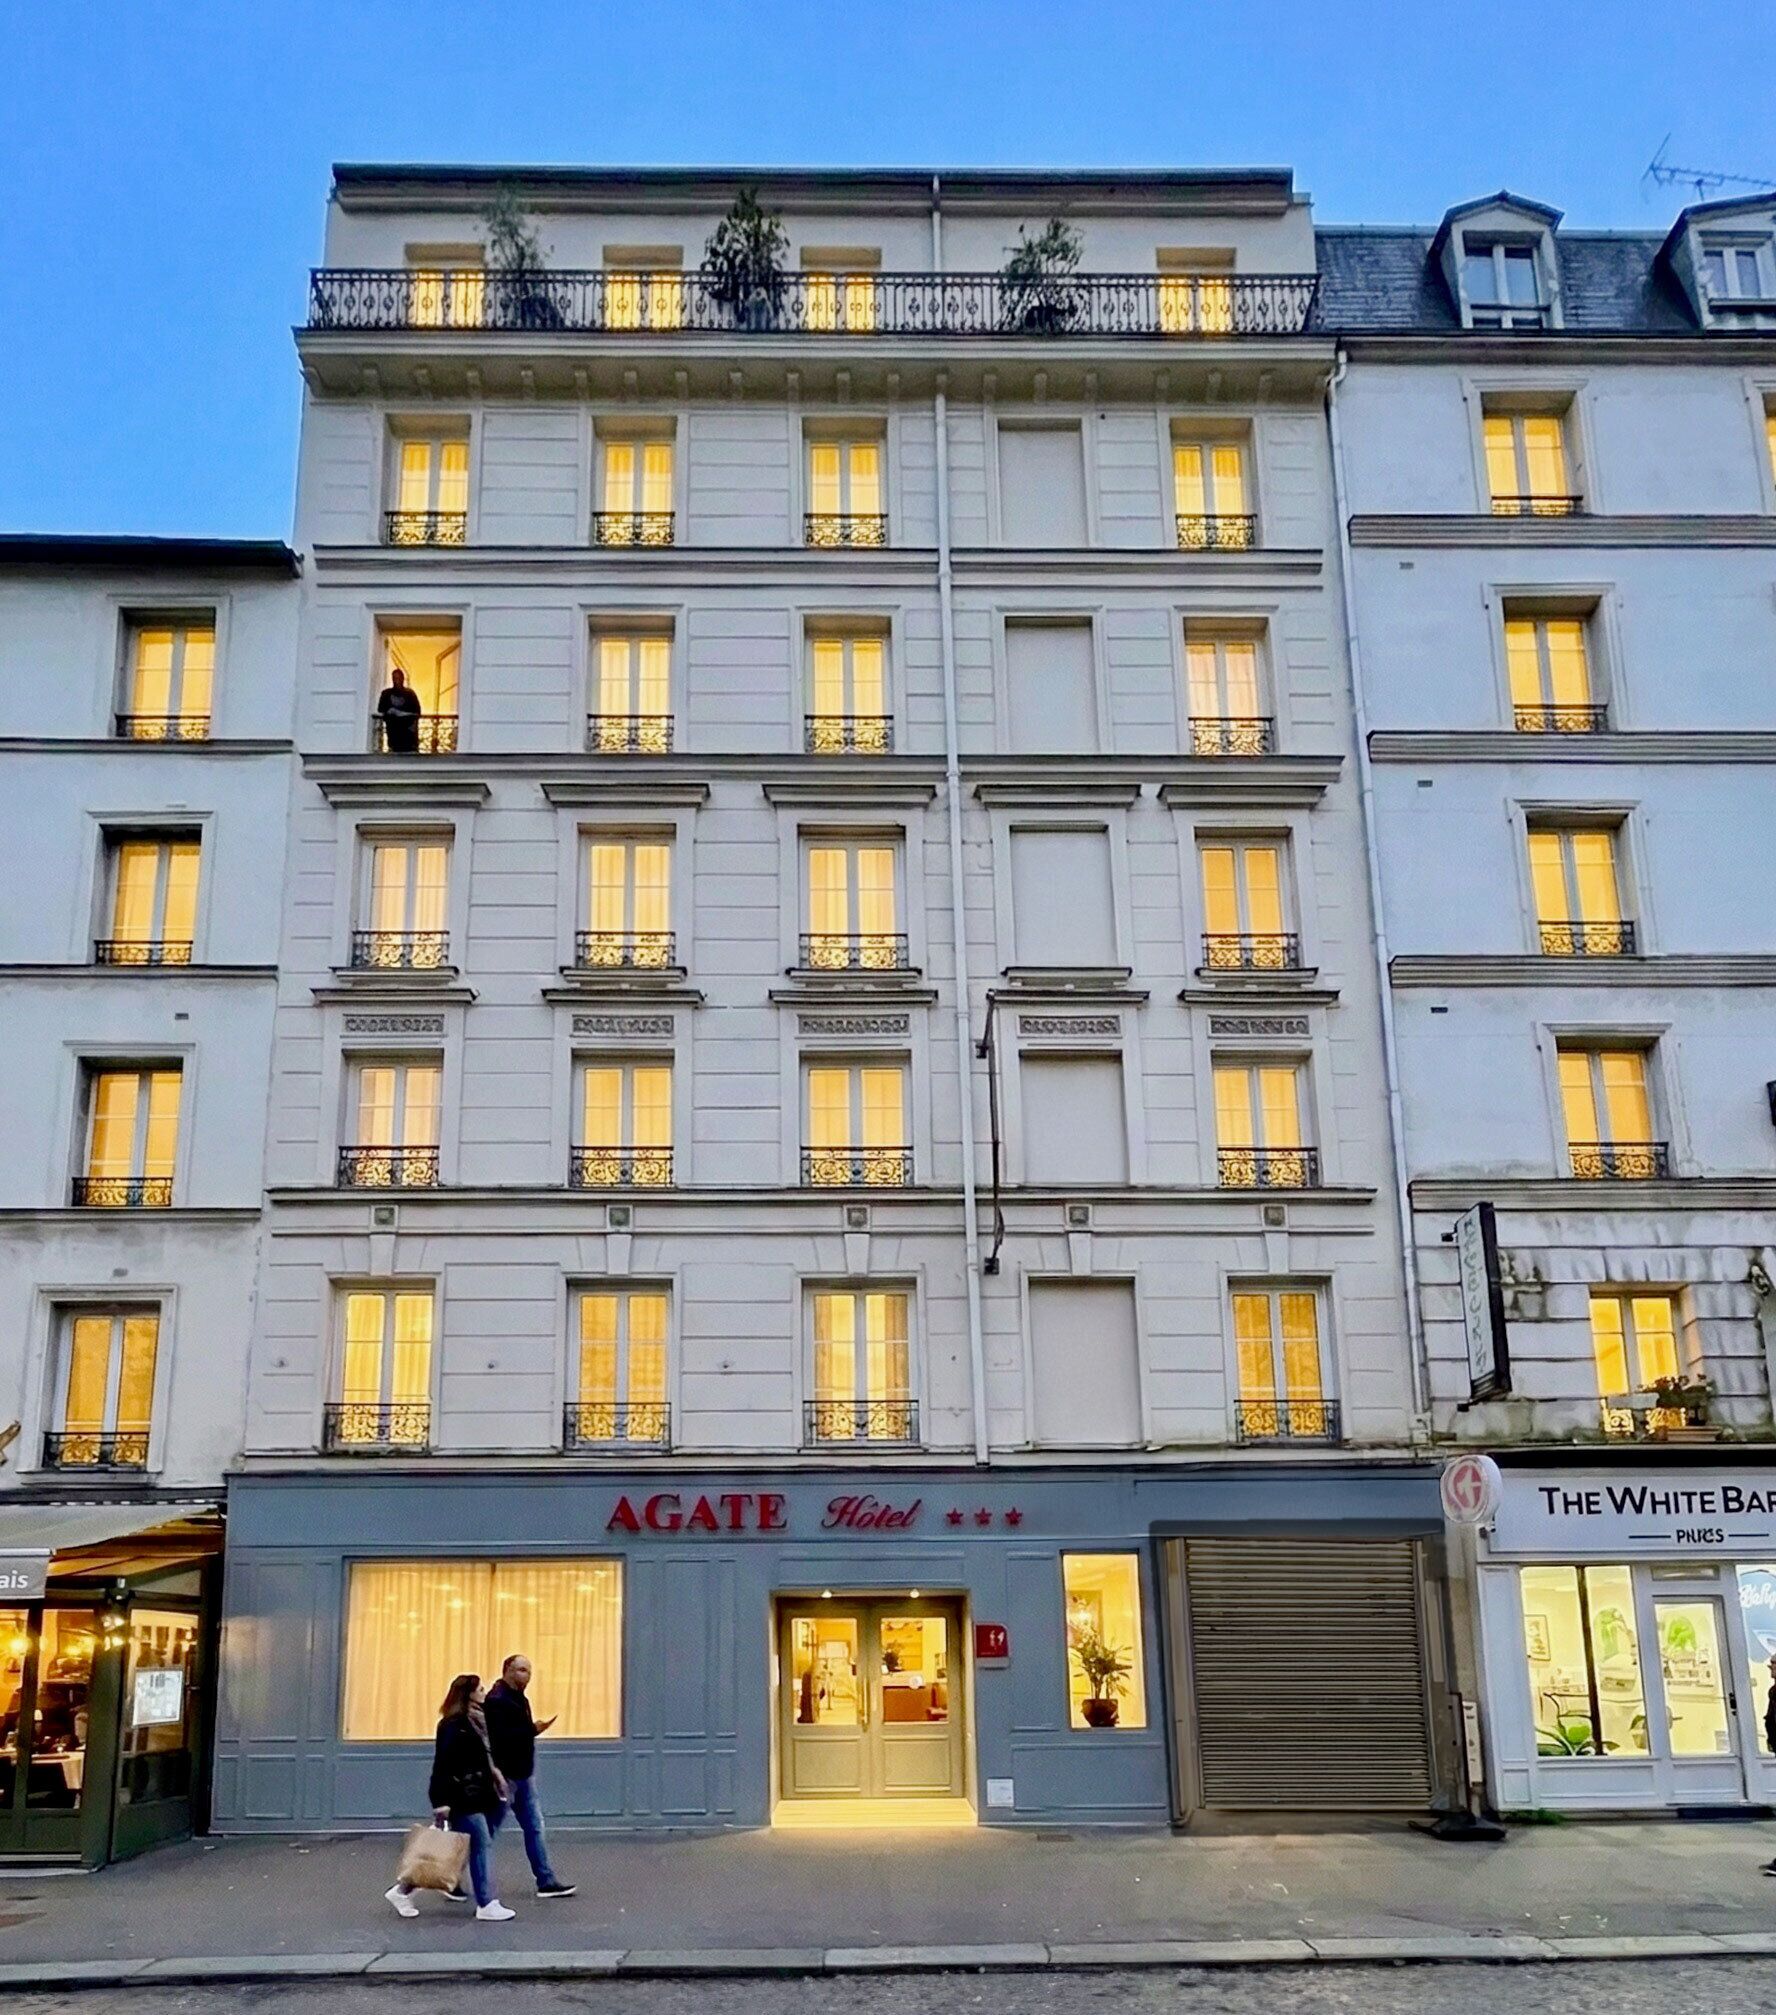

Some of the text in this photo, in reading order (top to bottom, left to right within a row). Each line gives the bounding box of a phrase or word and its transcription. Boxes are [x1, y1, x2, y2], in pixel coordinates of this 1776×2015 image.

[606, 1493, 921, 1531] AGATE Hôtel
[1538, 1487, 1601, 1515] THE
[1606, 1486, 1716, 1514] WHITE
